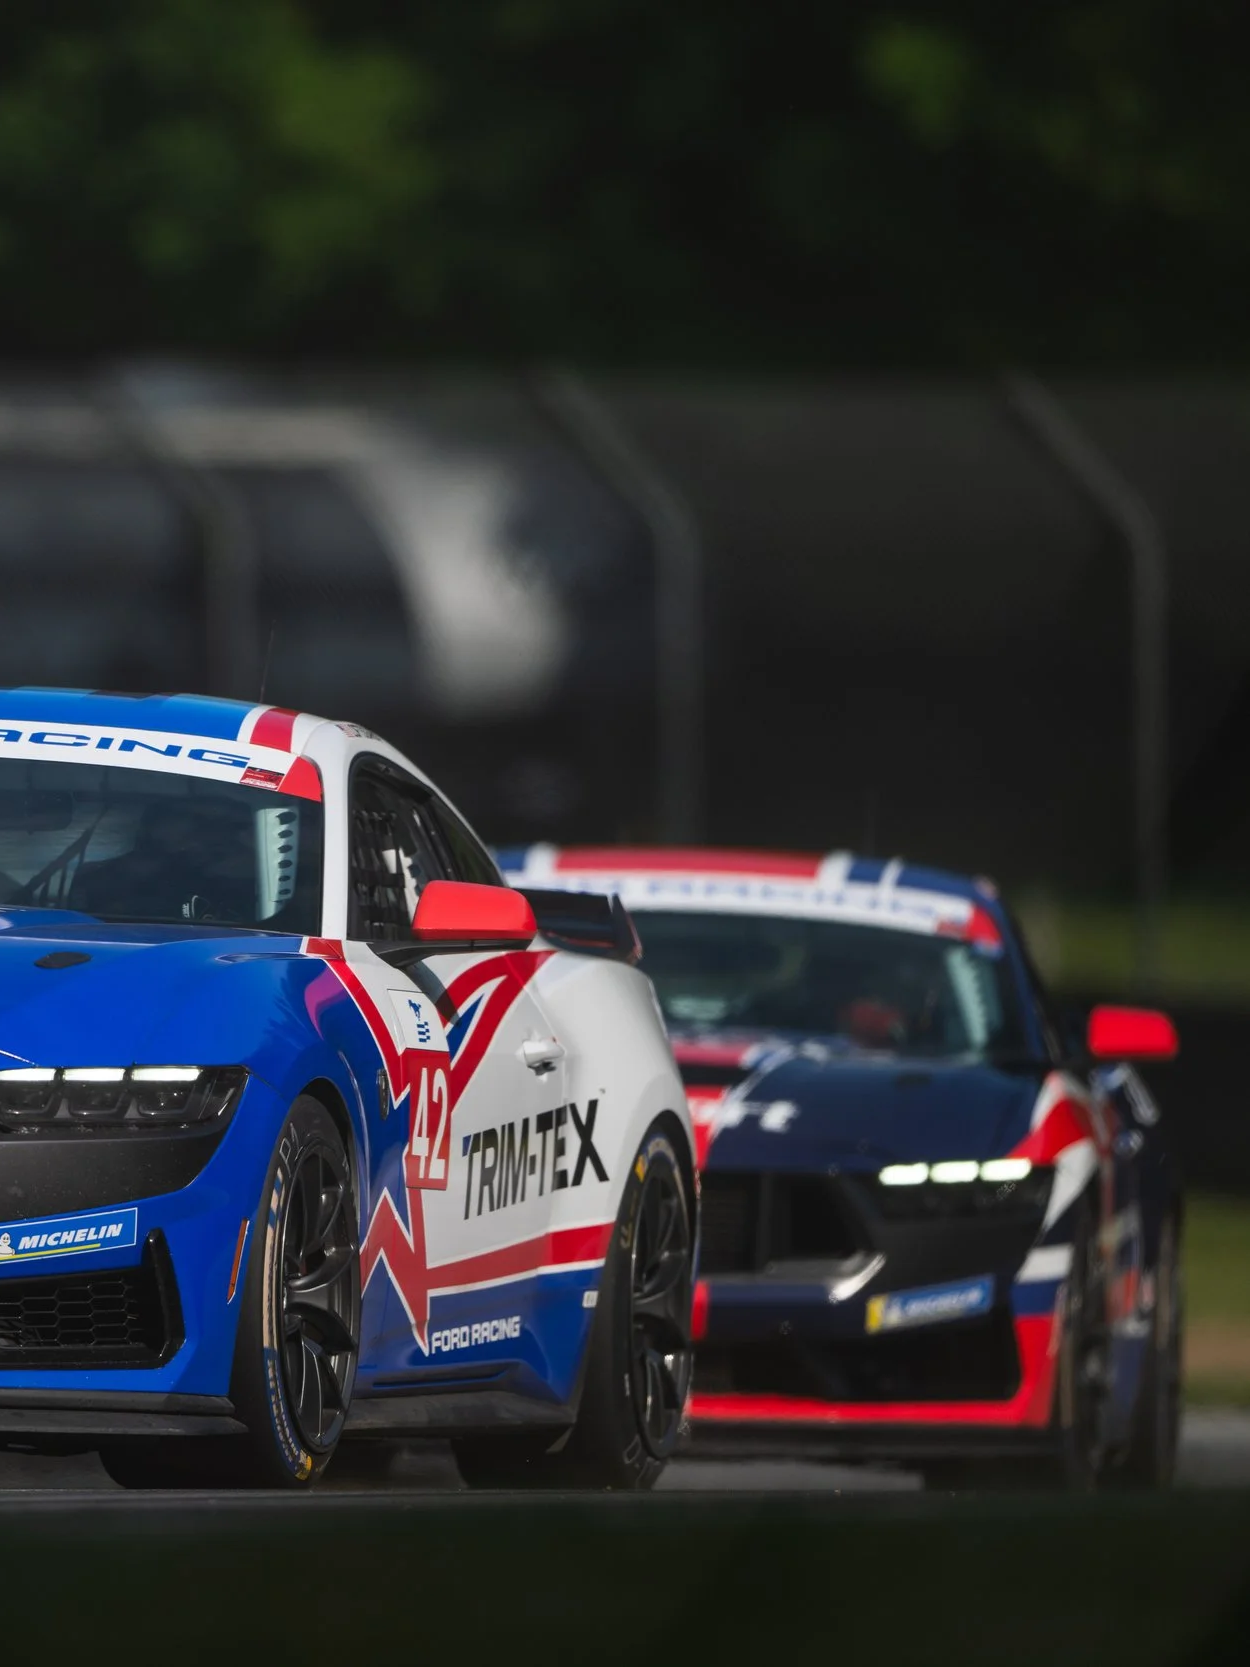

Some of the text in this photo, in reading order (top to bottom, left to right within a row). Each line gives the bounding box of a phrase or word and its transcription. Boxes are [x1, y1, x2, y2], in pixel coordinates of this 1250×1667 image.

[411, 1067, 448, 1180] 42
[462, 1098, 610, 1221] TRIM-TEX
[18, 1223, 123, 1250] MICHELIN
[431, 1315, 521, 1354] FORD RACING
